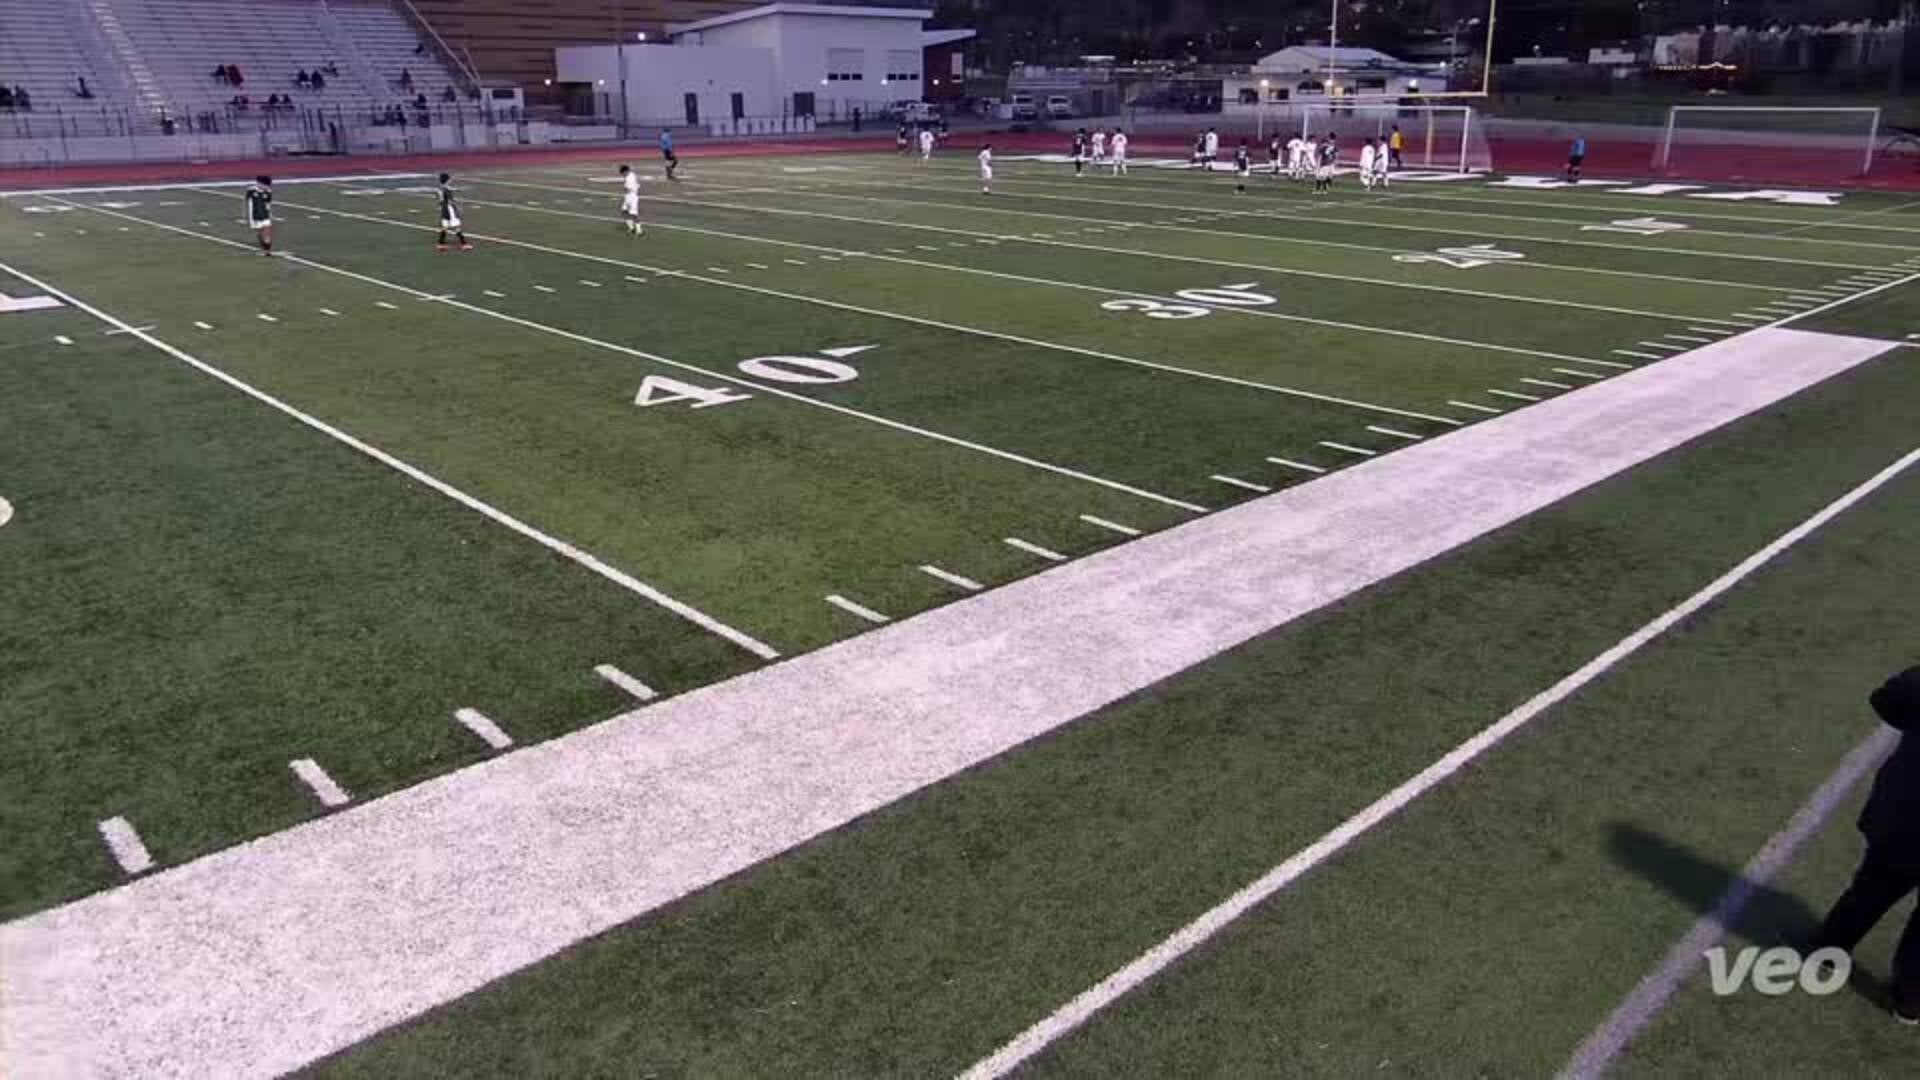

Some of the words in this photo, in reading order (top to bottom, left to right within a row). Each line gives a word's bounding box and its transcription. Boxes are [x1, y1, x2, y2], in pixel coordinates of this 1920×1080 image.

[1392, 247, 1525, 269] 20
[1101, 289, 1277, 318] 30
[634, 355, 859, 408] 40
